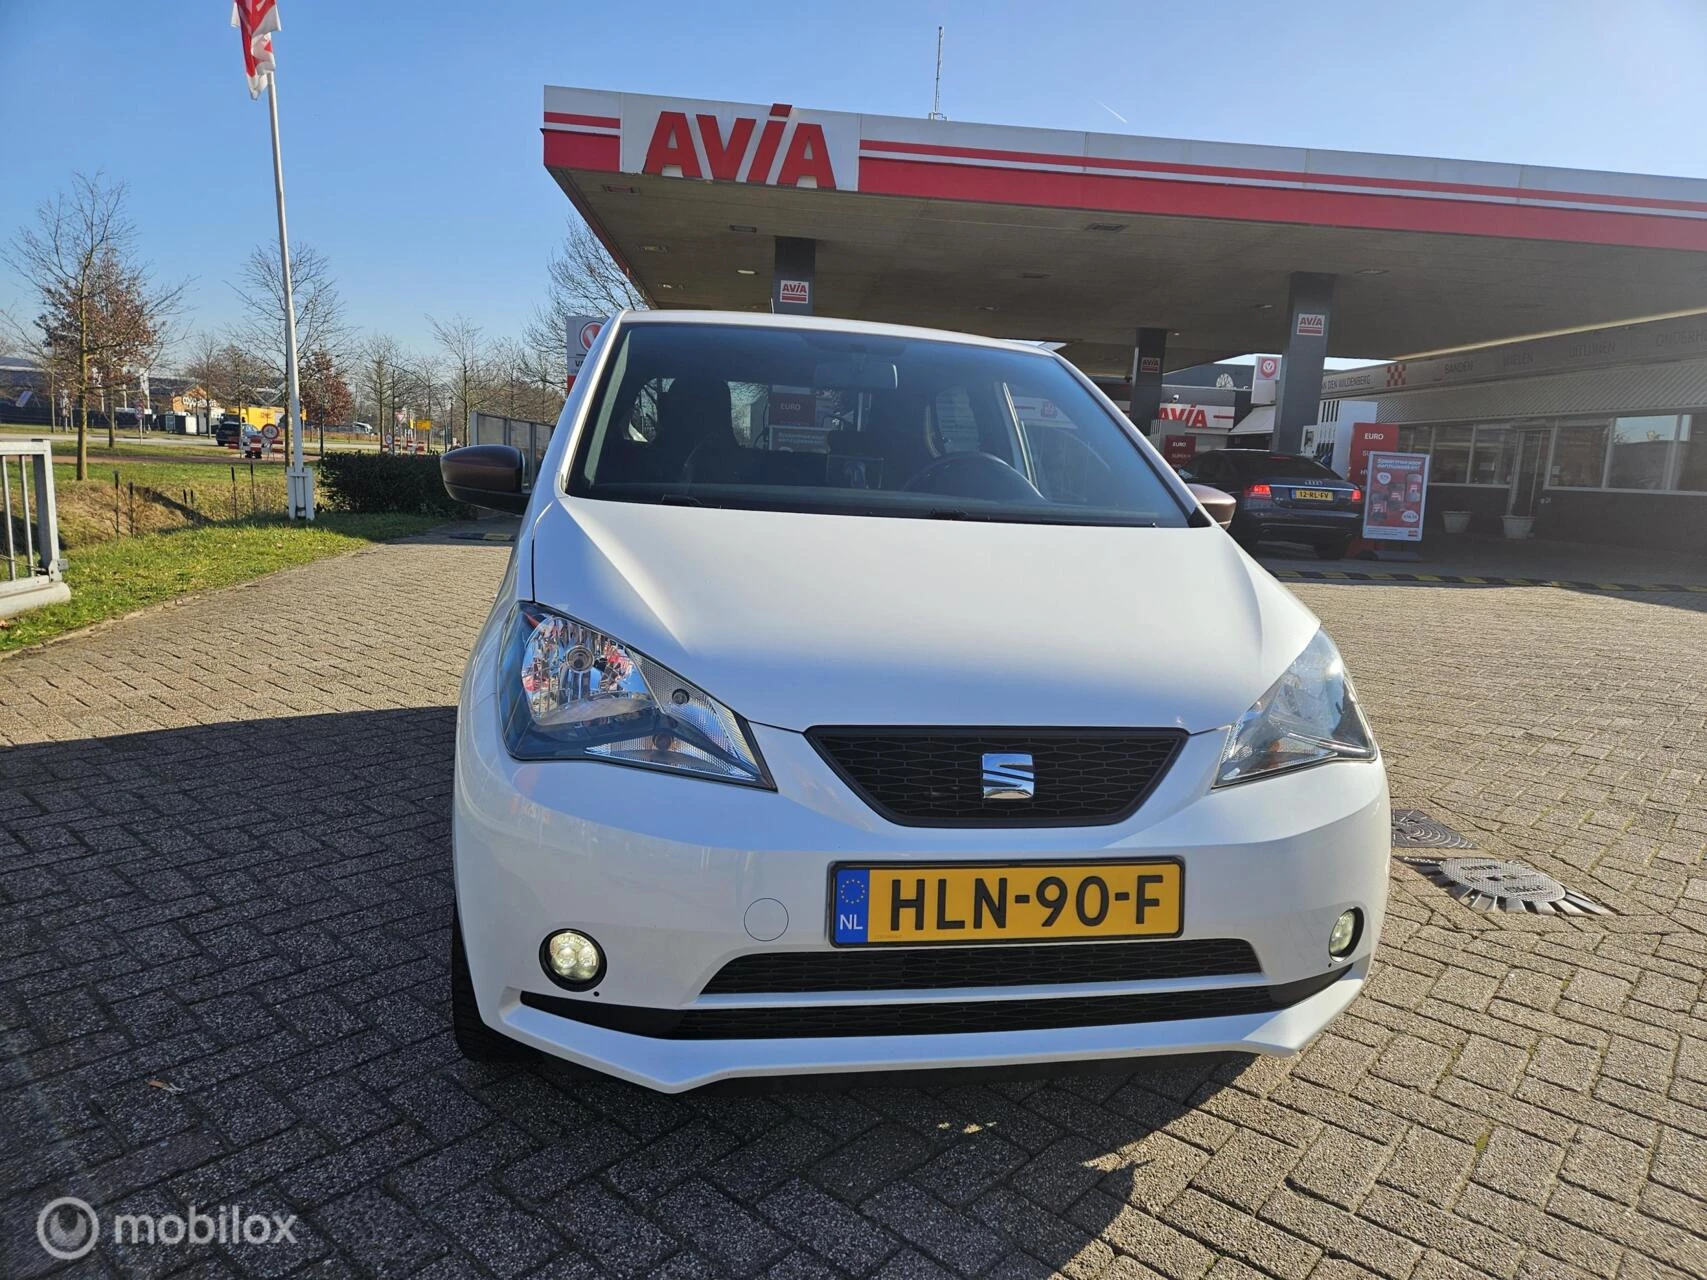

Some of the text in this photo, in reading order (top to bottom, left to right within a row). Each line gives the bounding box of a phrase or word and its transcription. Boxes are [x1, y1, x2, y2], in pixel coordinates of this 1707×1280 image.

[1364, 432, 1384, 440] EURO
[890, 875, 1164, 931] HLN-90-F
[839, 914, 864, 930] NL
